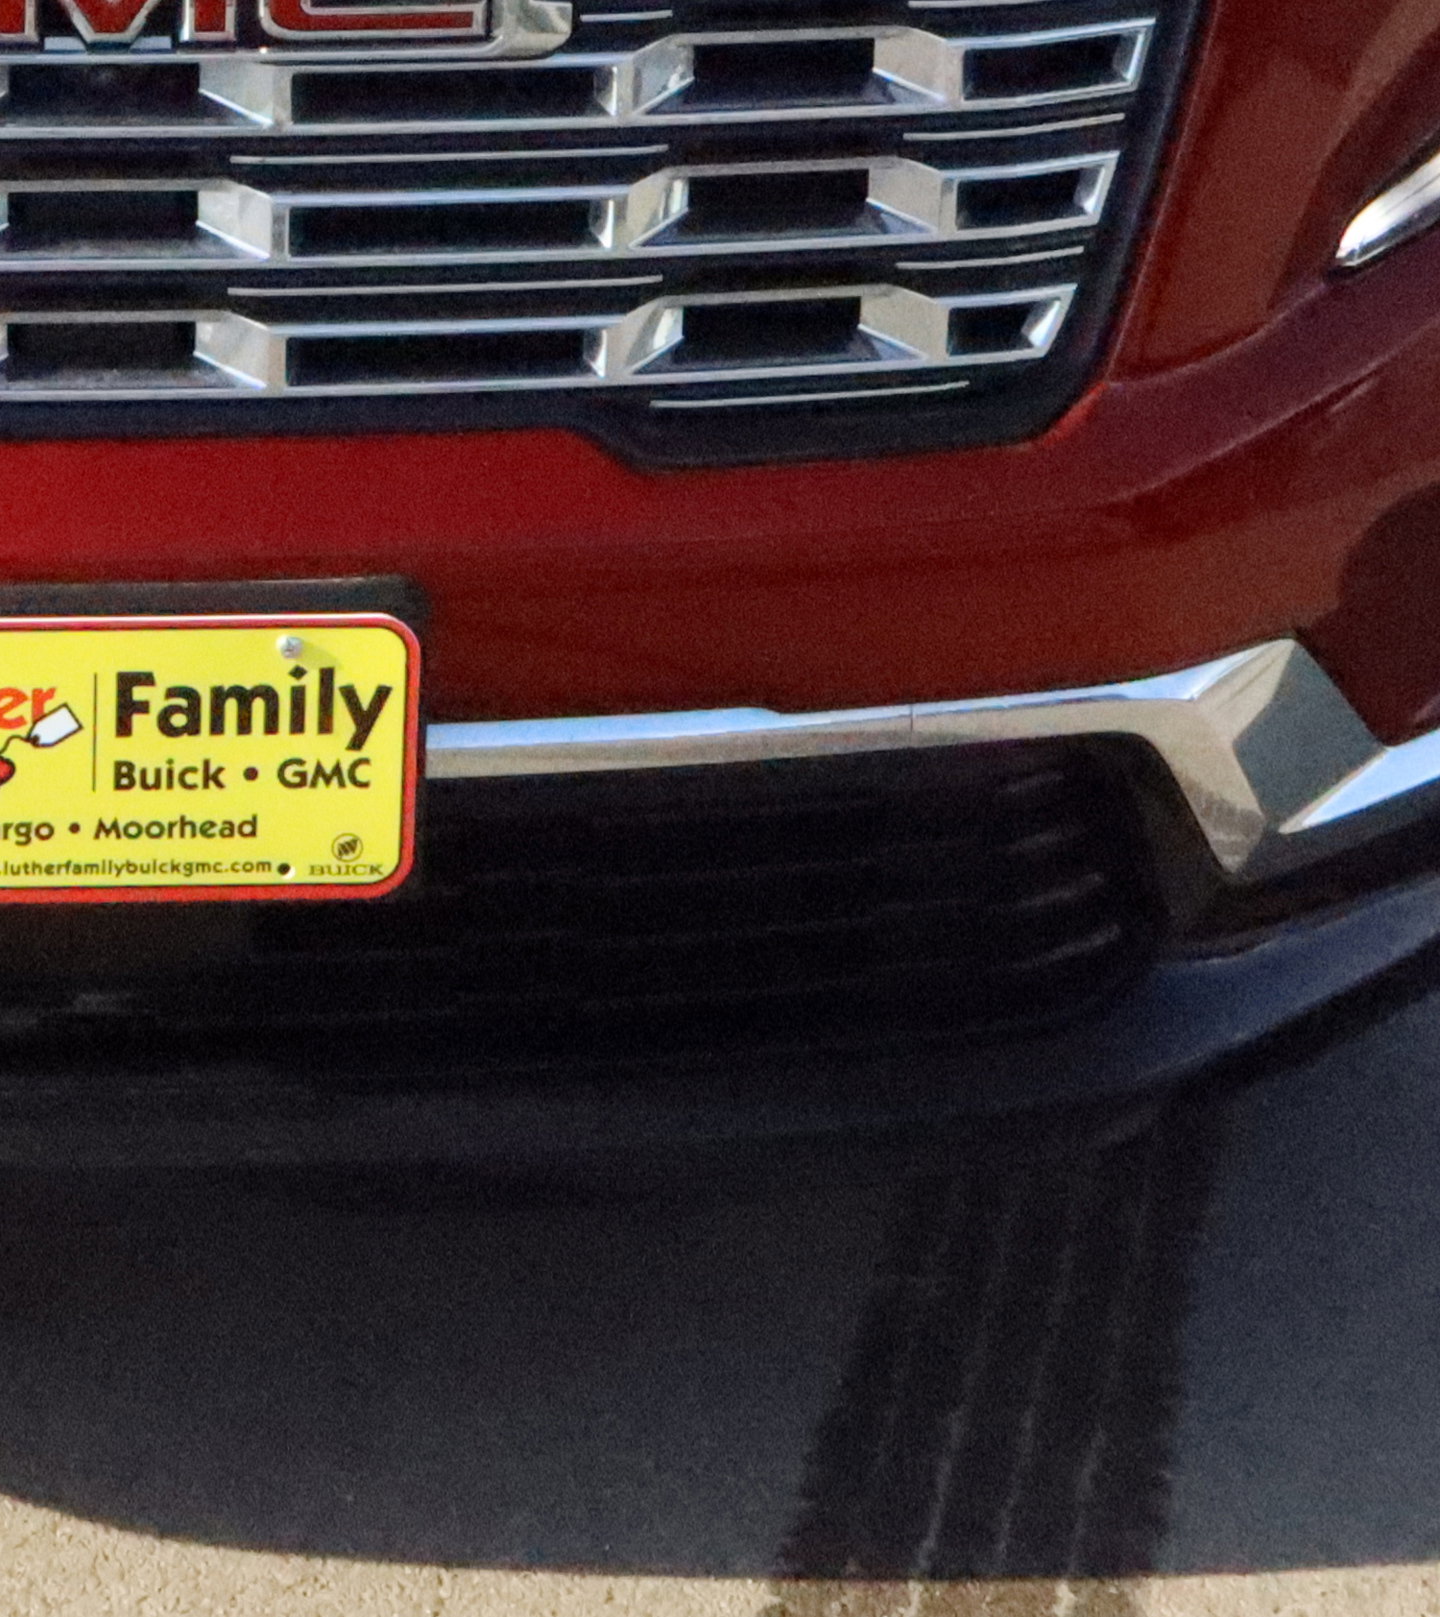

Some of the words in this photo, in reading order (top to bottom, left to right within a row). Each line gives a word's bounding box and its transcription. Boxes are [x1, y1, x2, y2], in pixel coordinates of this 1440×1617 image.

[115, 665, 393, 752] Family
[114, 759, 226, 792] Buick
[276, 757, 372, 789] GMC
[93, 814, 259, 841] Moorhead
[308, 863, 384, 877] BUICK
